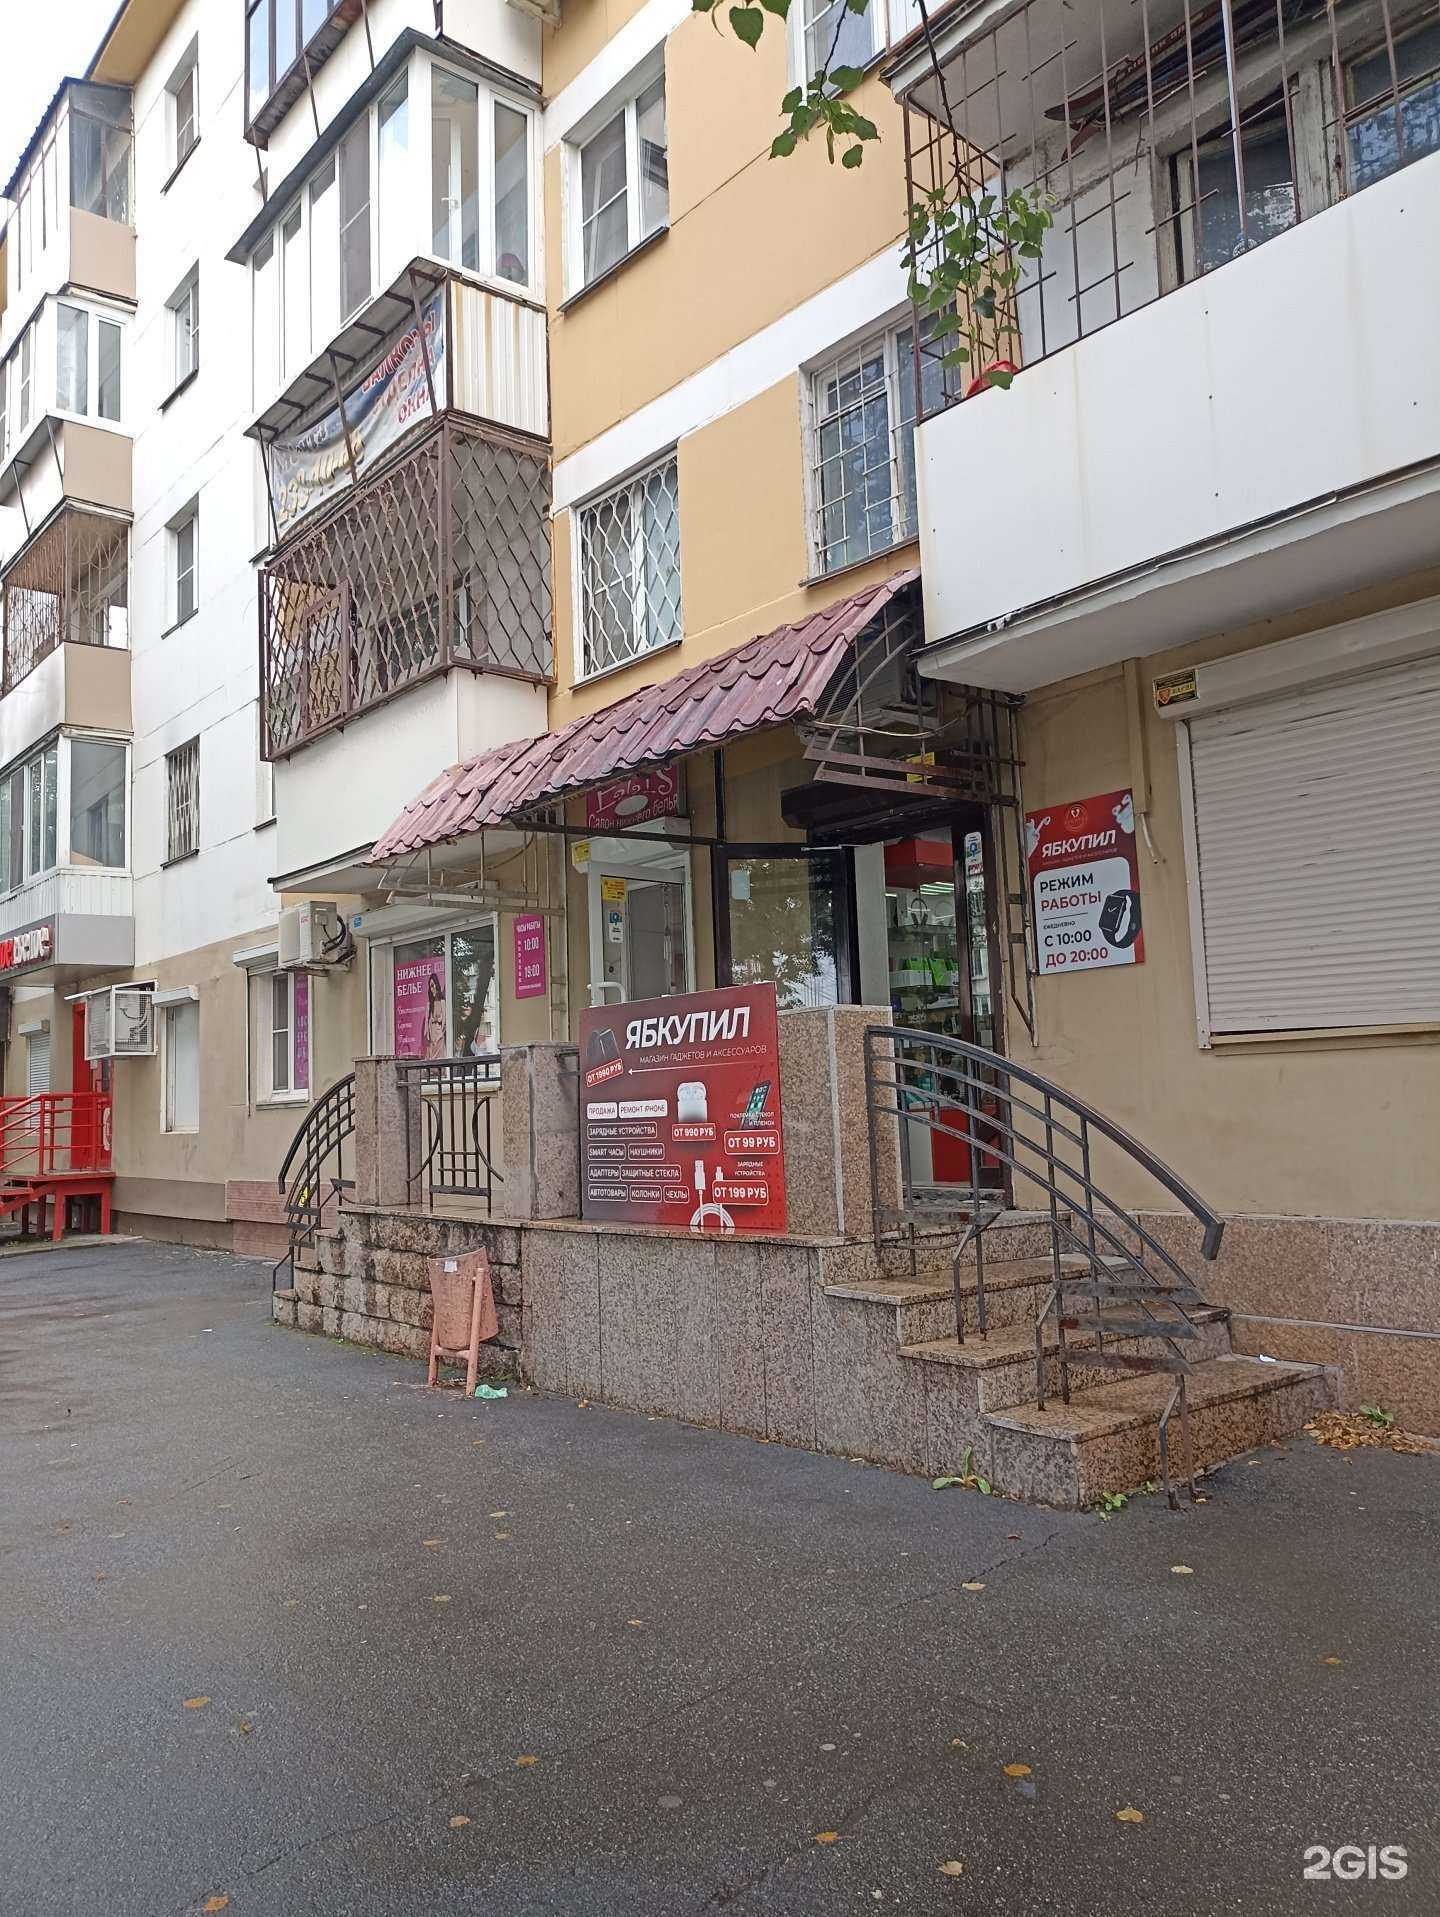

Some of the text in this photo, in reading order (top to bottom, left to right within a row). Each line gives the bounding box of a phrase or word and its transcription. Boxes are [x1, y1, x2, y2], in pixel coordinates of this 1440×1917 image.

[1042, 829, 1116, 858] ЯБКУПИЛ
[1040, 873, 1094, 893] РЕЖИМ
[1041, 891, 1101, 911] РАБОТЫ
[524, 936, 540, 951] 10:00
[1044, 929, 1092, 947] С 10:00
[1046, 947, 1109, 968] ДО 20:00
[397, 963, 432, 980] НИЖНЕЕ
[397, 981, 423, 997] БЕЛЬЕ
[625, 1006, 751, 1050] ЯБКУПИЛ
[639, 1045, 767, 1064] МАГАЗИН ГАДЖЕТОВ И АКСЕССУАРОВ
[587, 1074, 595, 1083] ОТ
[610, 1062, 622, 1073] РУБ
[588, 1106, 616, 1116] ПРОДАЖА
[620, 1104, 665, 1115] РЕМОНТ IPHONE
[589, 1125, 656, 1136] ЗАРЯДНЫЕ УСТРОЙСТВА
[674, 1127, 714, 1137] ОТ 990 РУБ
[728, 1137, 776, 1148] ОТ 99 РУБ
[589, 1148, 624, 1156] SMART ЧАСЫ
[630, 1147, 663, 1156] НАУШНИКИ
[589, 1169, 619, 1178] АДАПТЕРЫ
[621, 1169, 680, 1178] ЗАЩИТНЫЕ СТЕКЛА
[590, 1188, 626, 1198] АВТОТОВАРЫ
[631, 1189, 660, 1199] КОЛОНКИ
[666, 1190, 688, 1200] ЧЕХЛЫ
[714, 1186, 767, 1198] ОТ 199 РУБ
